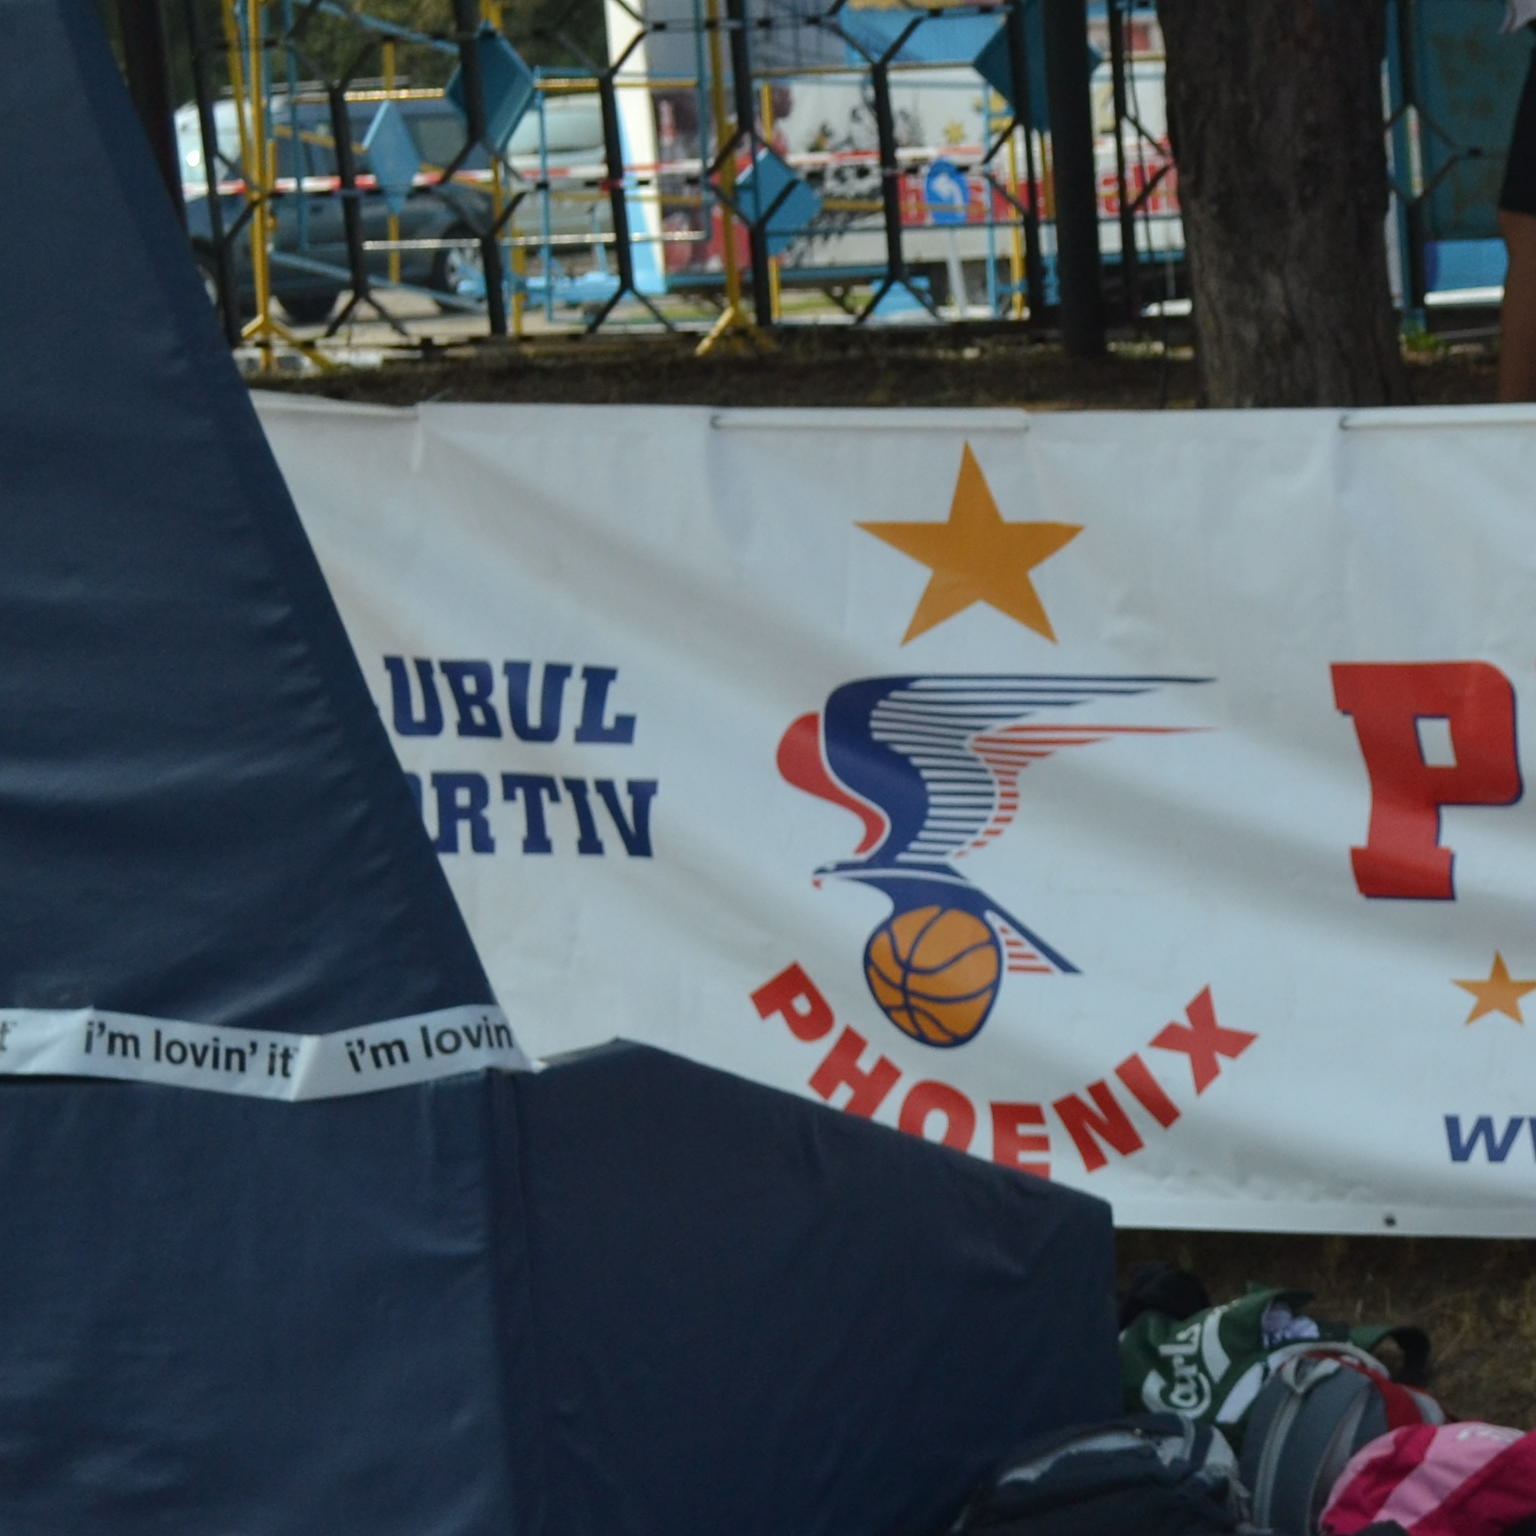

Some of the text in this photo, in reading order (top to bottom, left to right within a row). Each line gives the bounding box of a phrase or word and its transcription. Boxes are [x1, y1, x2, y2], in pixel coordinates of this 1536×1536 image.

[380, 654, 637, 746] UBUL
[83, 1020, 141, 1060] i'm
[154, 1031, 259, 1074] lovin'
[345, 1033, 409, 1073] i'm
